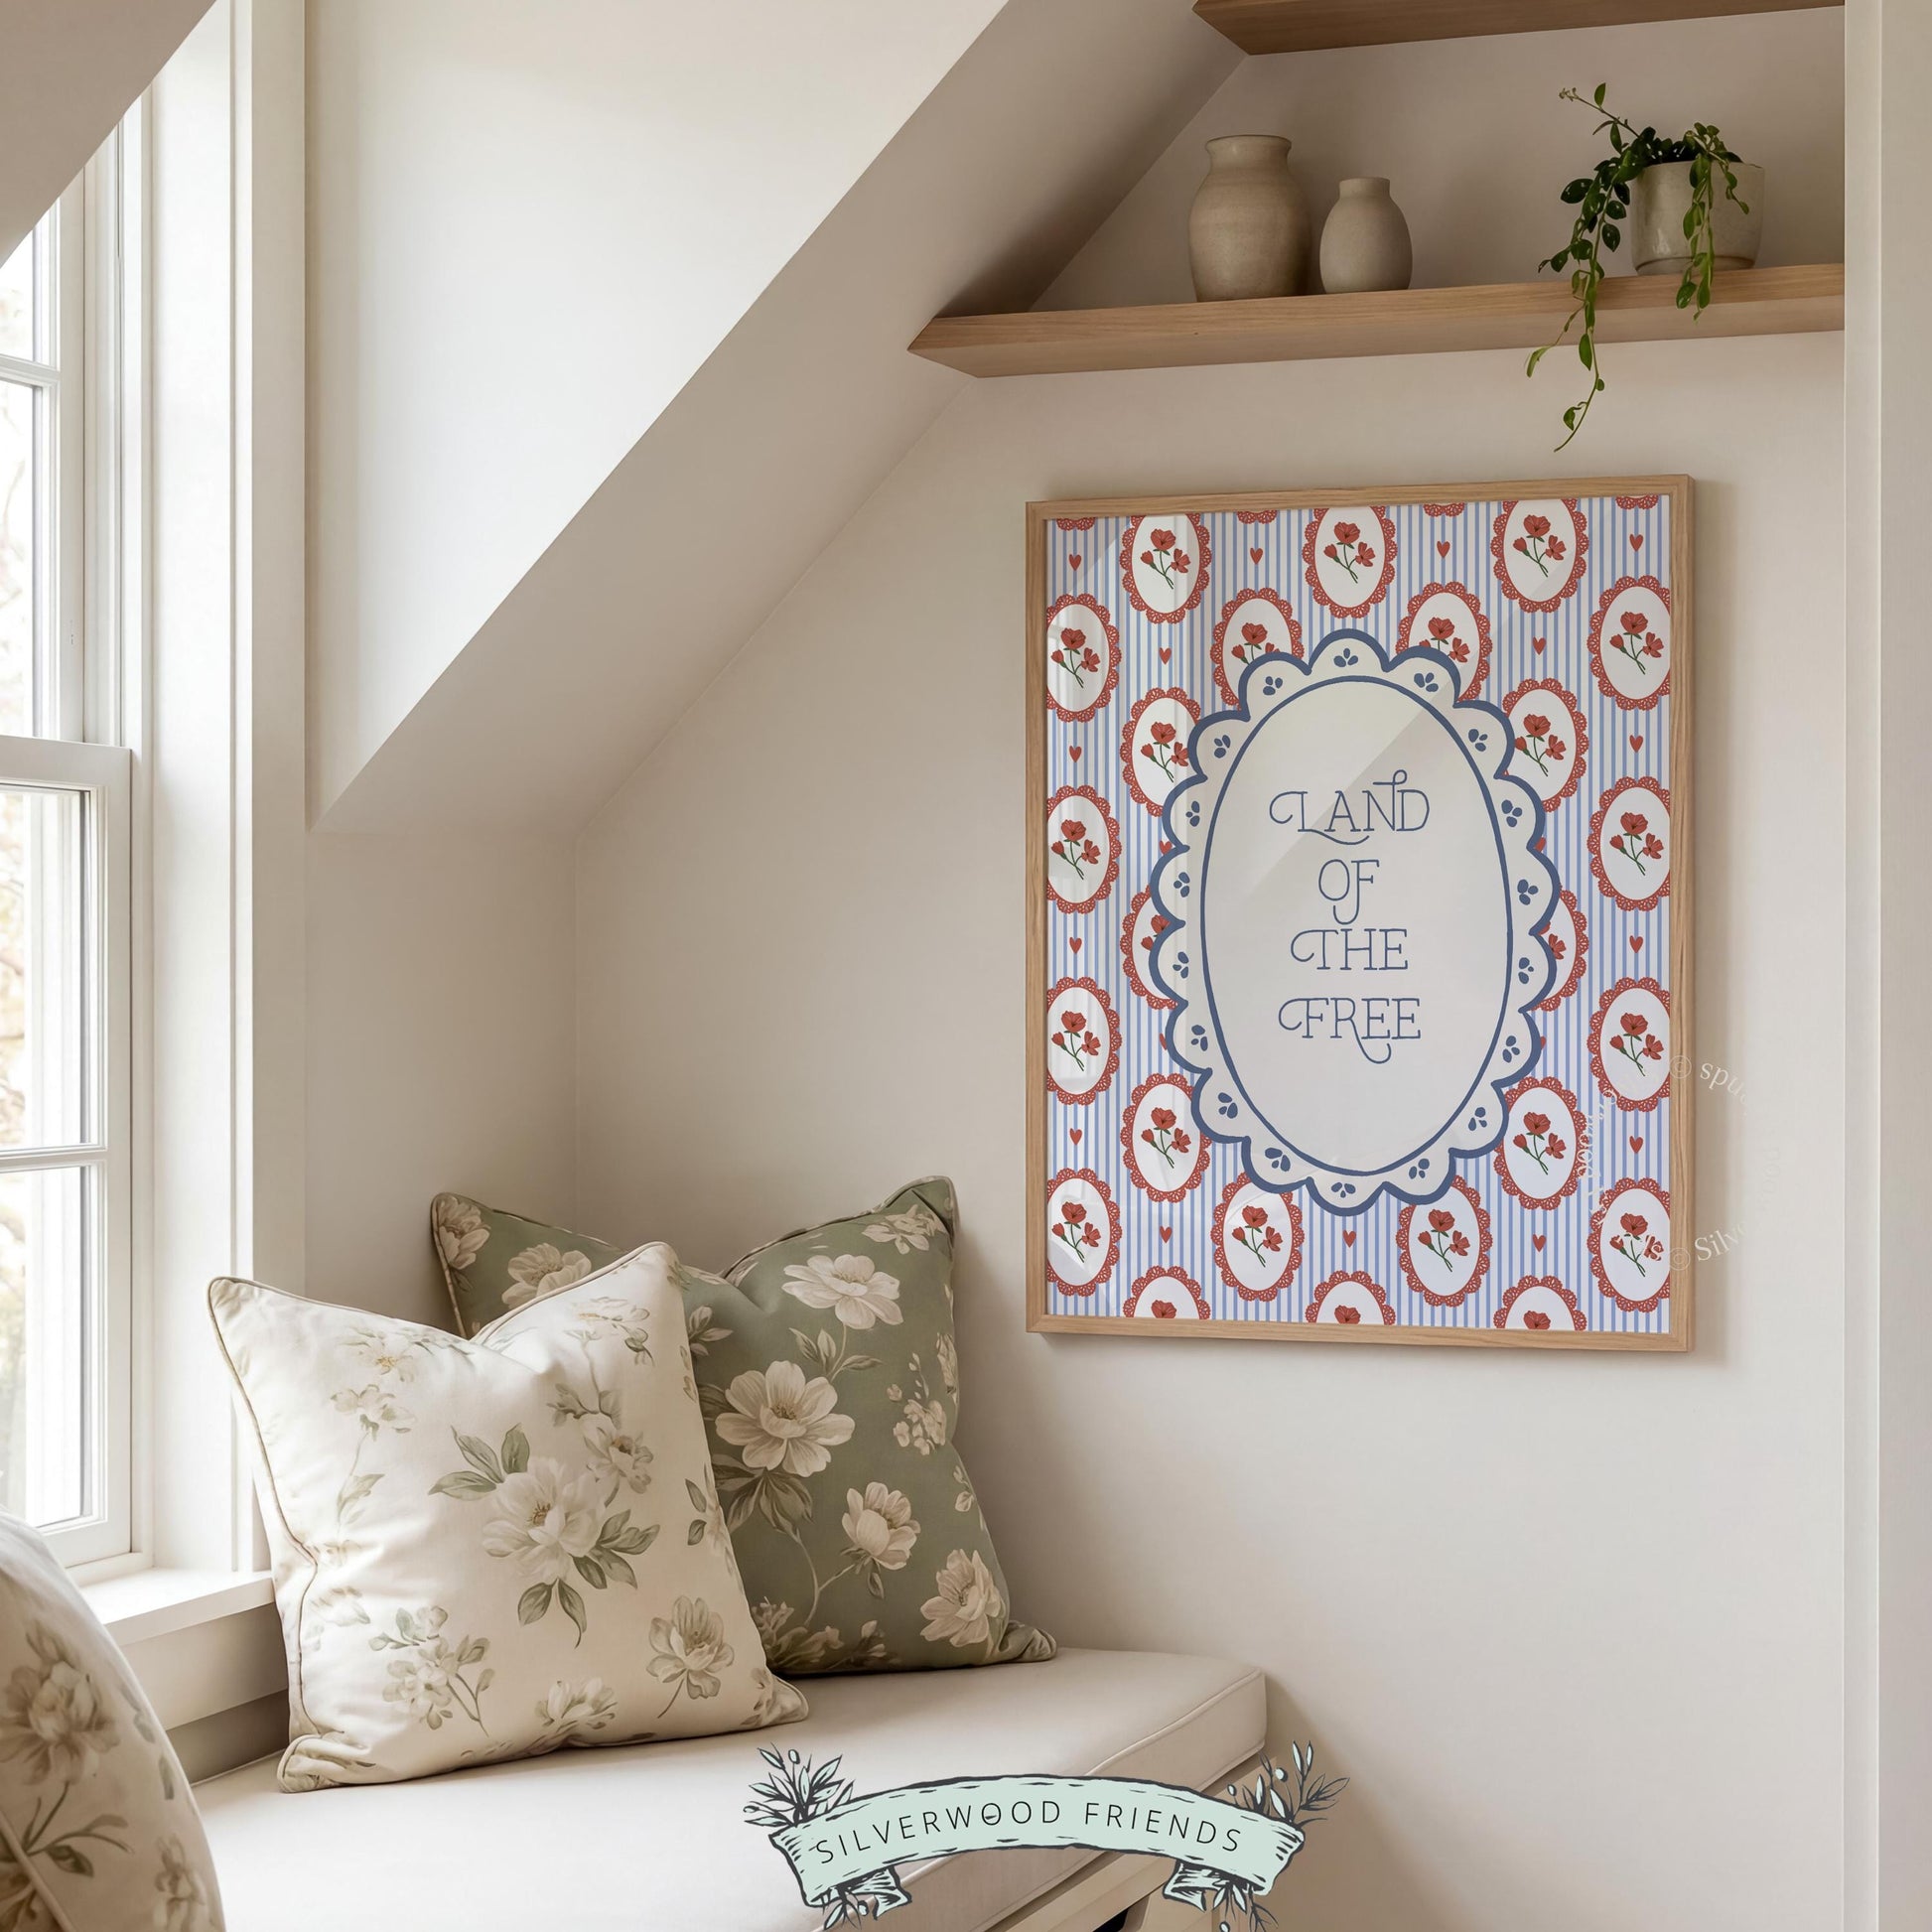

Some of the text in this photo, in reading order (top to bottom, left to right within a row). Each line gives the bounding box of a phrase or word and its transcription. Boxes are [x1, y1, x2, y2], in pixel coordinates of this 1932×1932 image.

[1269, 769, 1431, 846] LAND
[1317, 859, 1380, 925] OF
[1290, 928, 1409, 971] THE
[1278, 997, 1422, 1065] FREE
